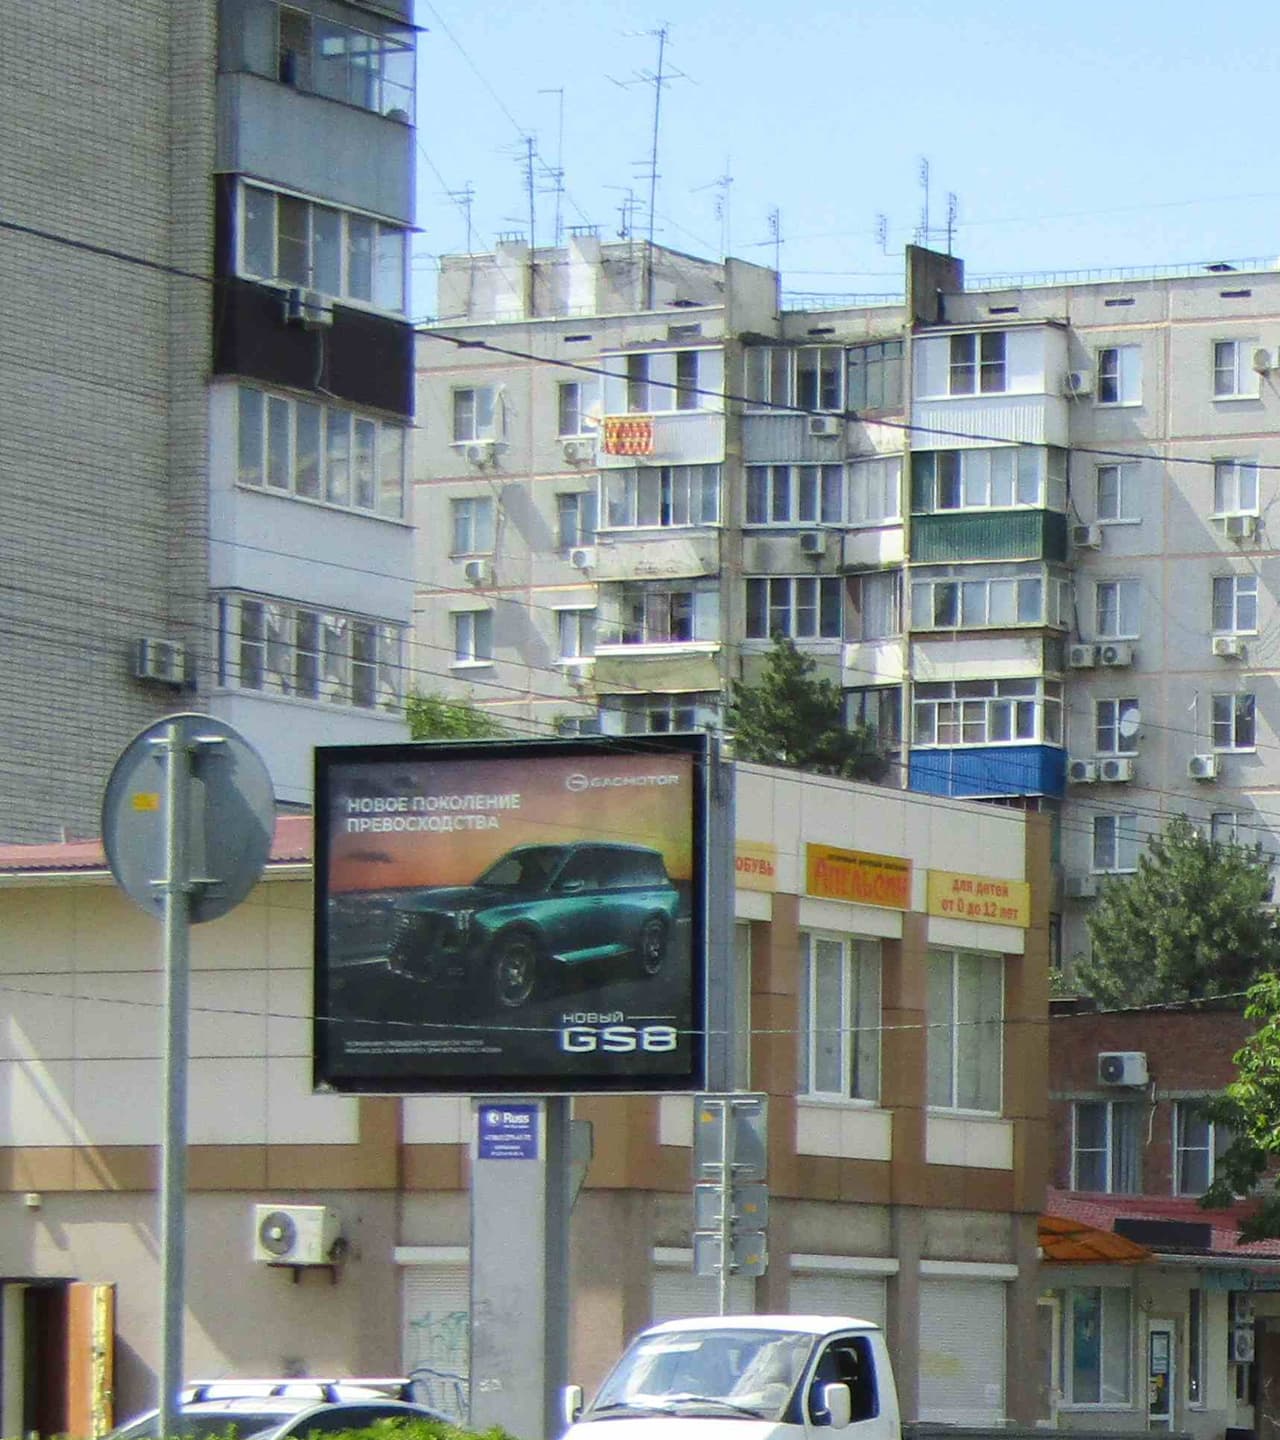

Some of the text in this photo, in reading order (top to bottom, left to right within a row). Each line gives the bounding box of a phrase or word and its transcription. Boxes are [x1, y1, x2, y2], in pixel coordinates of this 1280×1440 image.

[347, 794, 521, 813] НОВОЕ ПОКОЛЕНИЕ
[347, 815, 500, 833] ПРЕВОСХОДСТВА
[735, 856, 775, 877] ОБУВЬ
[952, 879, 1008, 897] для детей
[942, 898, 1018, 920] от 0 до 12 лет
[562, 1011, 625, 1024] НОВЫЙ
[561, 1026, 678, 1053] GS8
